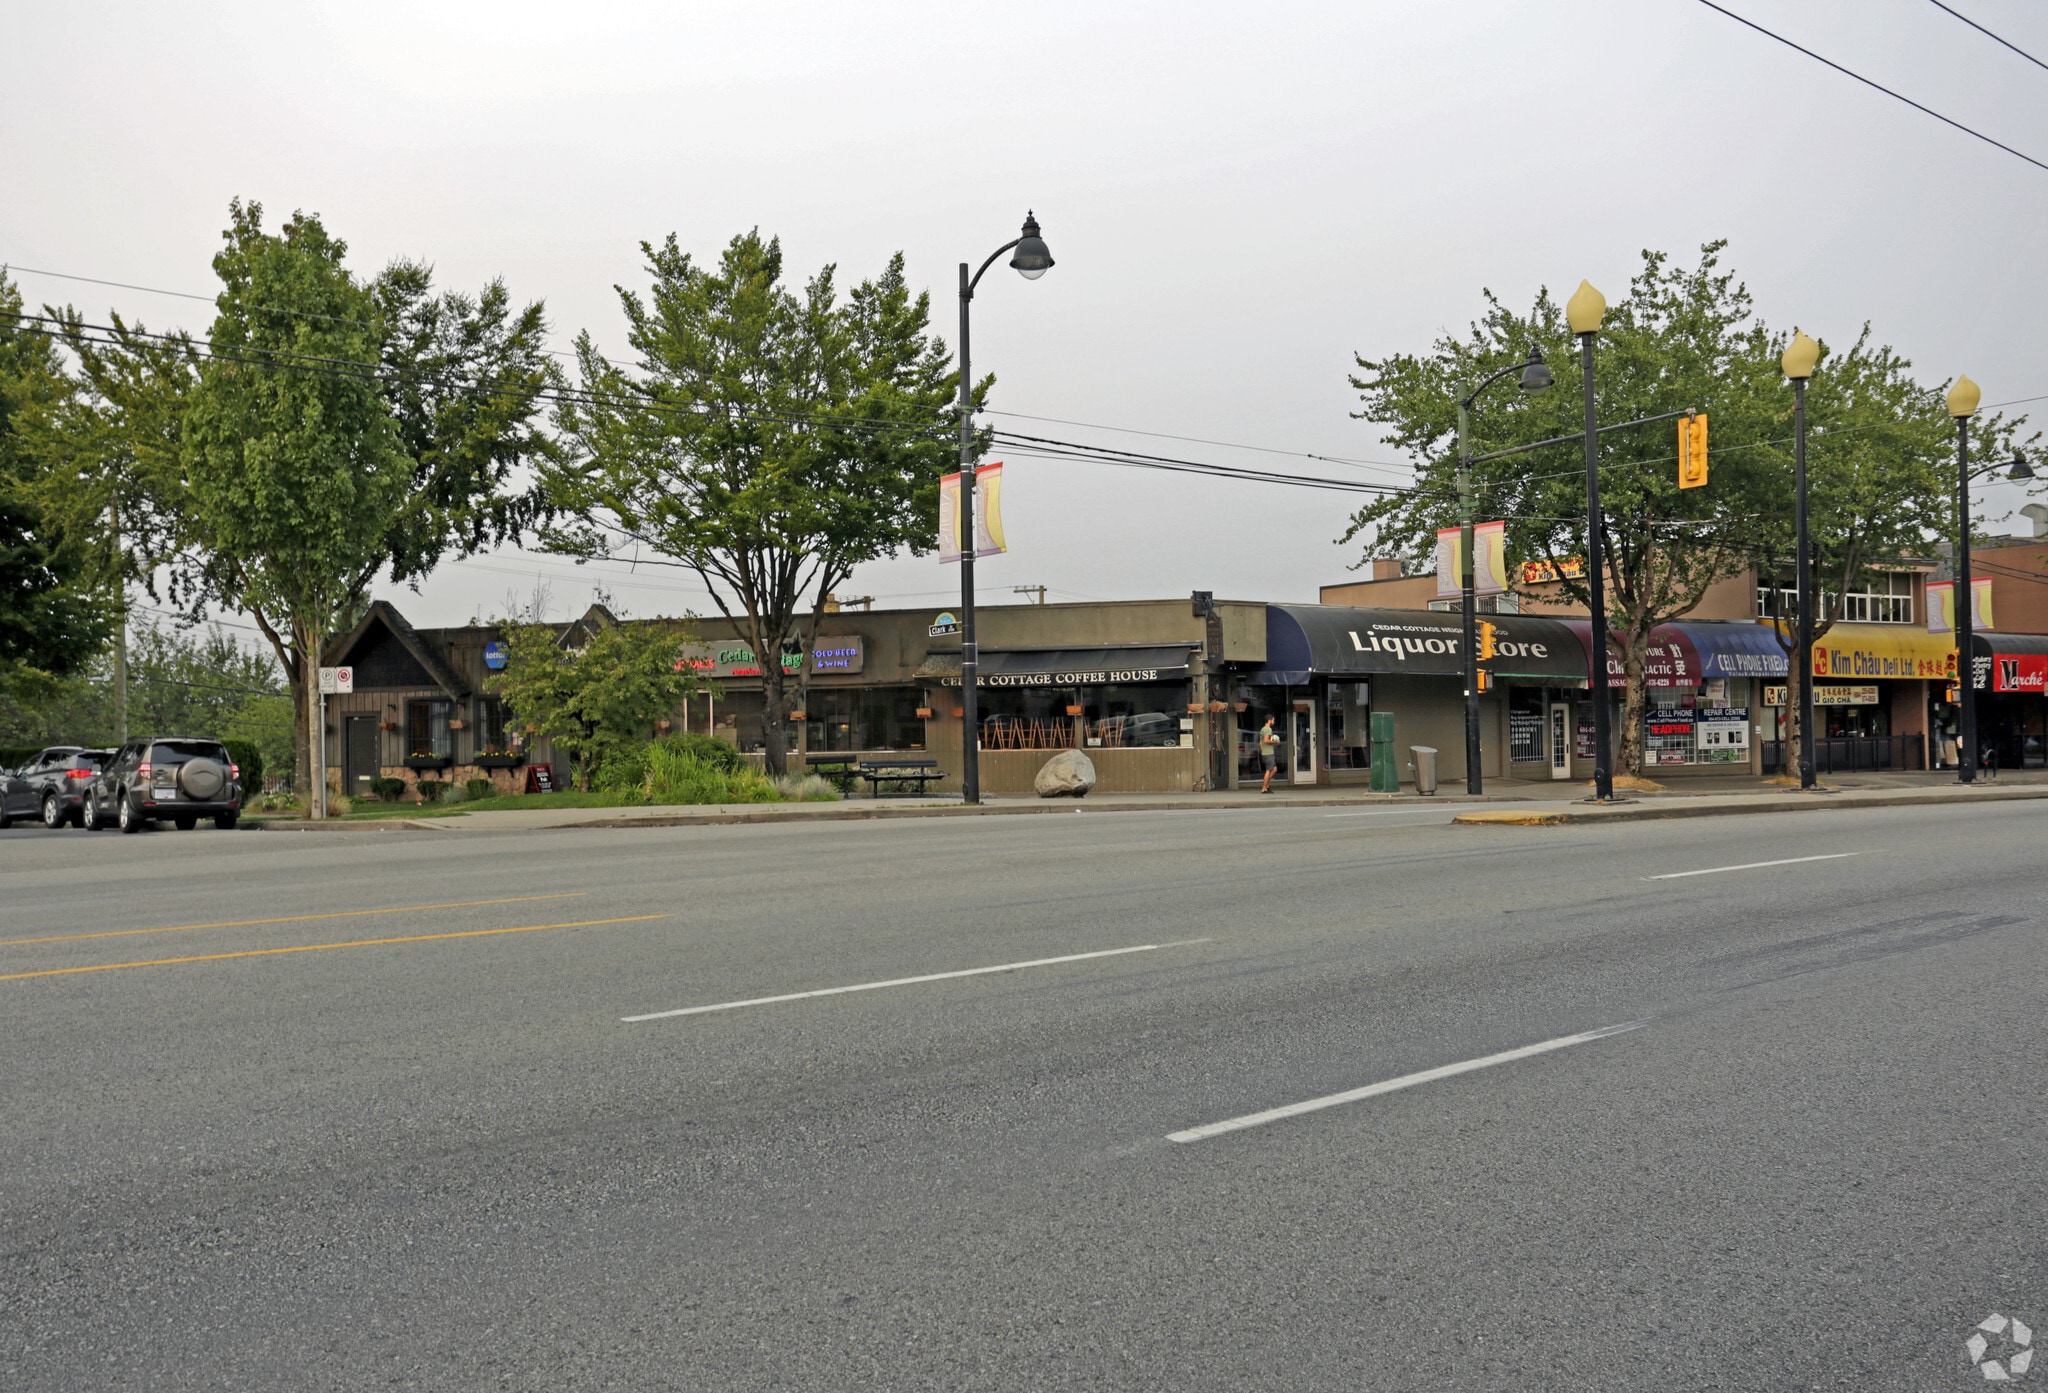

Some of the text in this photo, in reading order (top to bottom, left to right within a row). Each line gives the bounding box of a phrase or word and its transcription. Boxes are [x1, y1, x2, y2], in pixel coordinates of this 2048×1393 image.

[931, 625, 946, 635] Clark
[1372, 623, 1402, 632] CEDAR
[1403, 625, 1441, 633] COTTAGE
[1348, 630, 1459, 660] Liquor
[718, 648, 755, 665] Cedar
[835, 648, 857, 657] BEER
[825, 659, 850, 668] WINE
[1718, 654, 1737, 671] CELL
[1736, 654, 1763, 671] PHONE
[1831, 650, 1915, 676] Kim Châu Deli Ltd.
[990, 675, 1051, 686] COTTAGE
[1055, 672, 1105, 684] COFFEE
[1110, 670, 1157, 682] HOUSE
[2000, 659, 2043, 690] Marché
[1674, 709, 1694, 717] PHONE
[1703, 708, 1746, 716] REPAIR CENTRE
